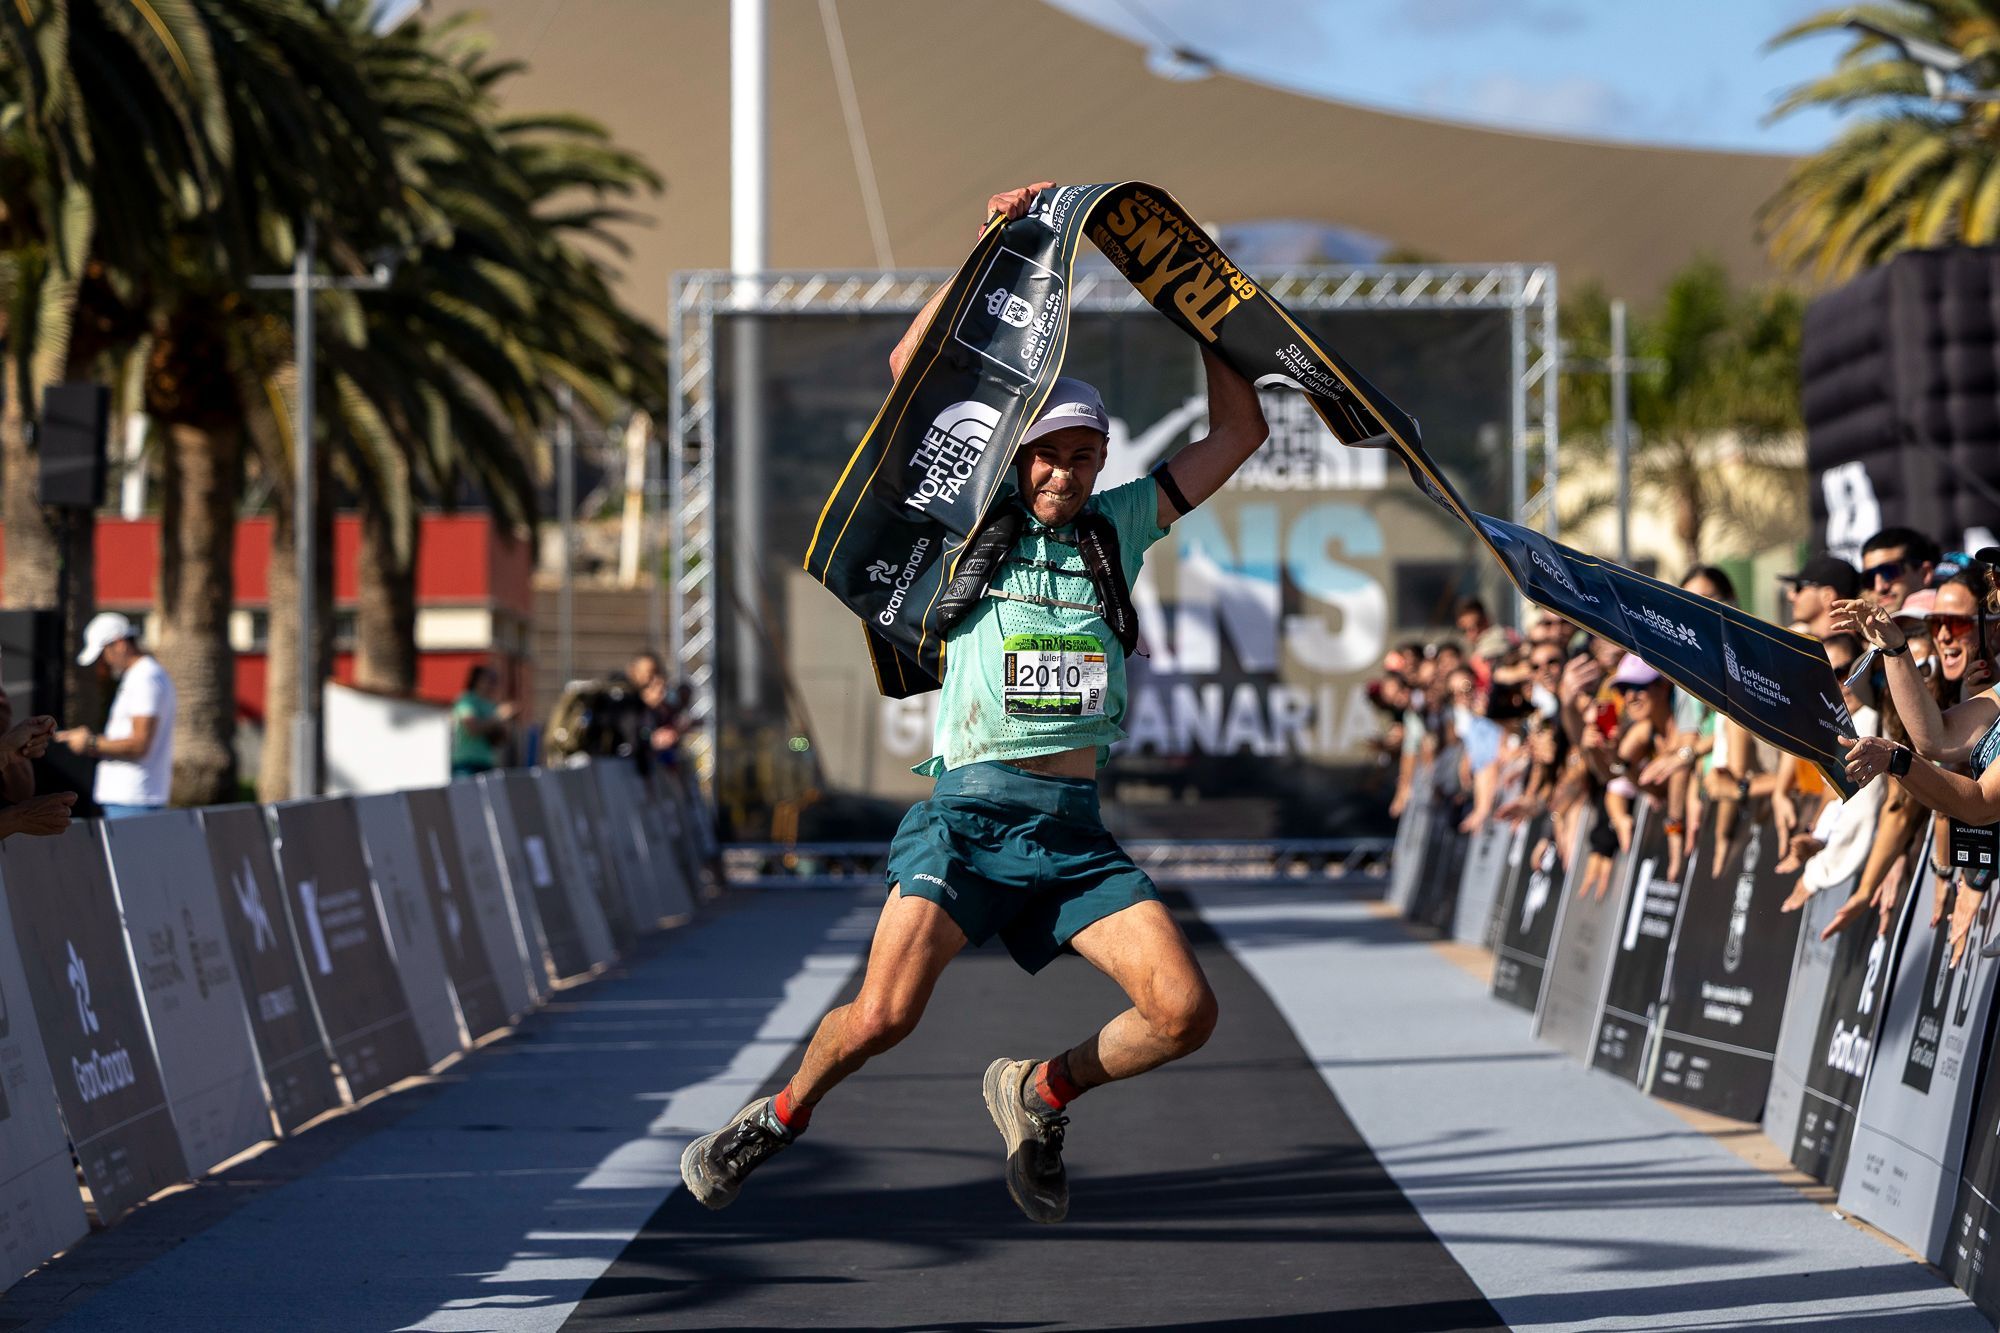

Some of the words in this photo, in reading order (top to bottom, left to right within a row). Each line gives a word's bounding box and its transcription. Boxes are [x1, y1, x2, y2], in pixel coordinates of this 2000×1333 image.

[1134, 190, 1210, 254] CANARIA
[1106, 197, 1241, 343] TRANS
[1206, 251, 1257, 300] GRAN
[1045, 293, 1056, 310] de
[1028, 339, 1047, 370] Gran
[1275, 348, 1305, 380] INSULAR
[1285, 343, 1336, 387] DEPORTES
[1304, 376, 1341, 401] INSTITUTO
[1335, 384, 1347, 392] DE
[909, 427, 945, 470] THE
[904, 434, 962, 512] NORTH
[937, 443, 982, 504] FACE
[879, 537, 931, 626] GranCanaria
[1620, 603, 1679, 638] Canarias
[1642, 605, 1674, 629] Islas
[1039, 653, 1063, 662] Julen
[1040, 635, 1073, 651] TRANS
[1019, 665, 1081, 688] 2010
[1740, 665, 1781, 691] Gobierno
[1742, 675, 1752, 687] de
[1752, 681, 1791, 705] Canarias
[1955, 826, 1993, 836] VOLUNTEERS
